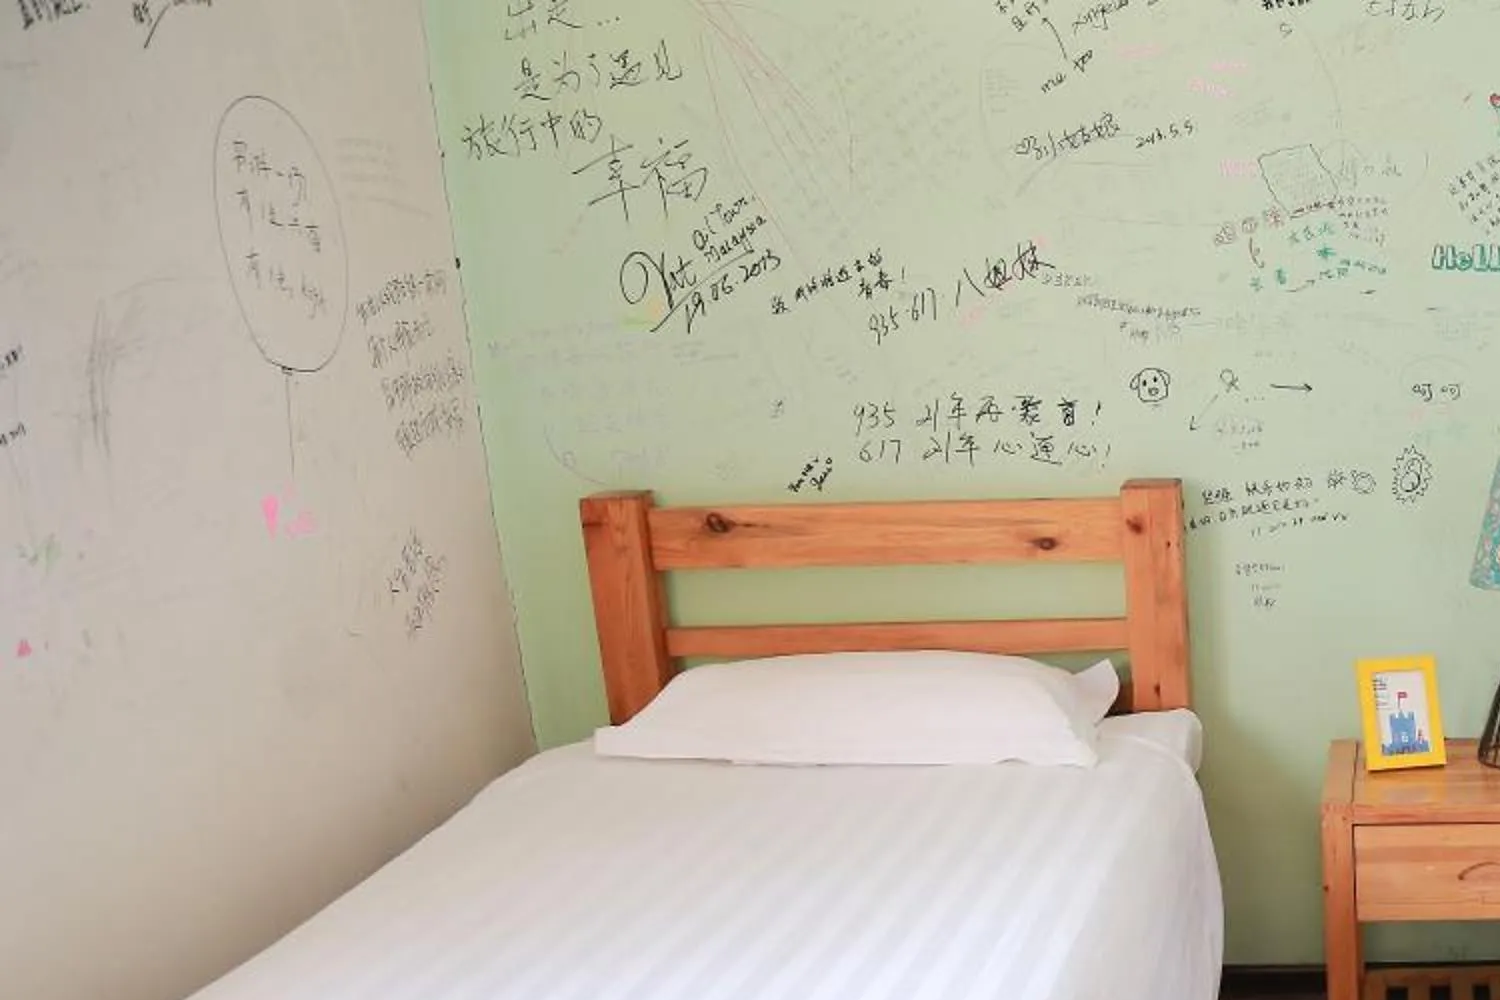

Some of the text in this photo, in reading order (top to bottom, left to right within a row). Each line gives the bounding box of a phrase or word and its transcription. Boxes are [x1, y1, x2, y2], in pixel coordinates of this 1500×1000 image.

[514, 39, 683, 100] 是为了遇见
[461, 108, 602, 160] 旅行中的
[571, 134, 708, 224] 幸福
[703, 213, 768, 264] Malaysia
[853, 401, 897, 437] 935
[858, 439, 901, 465] 617
